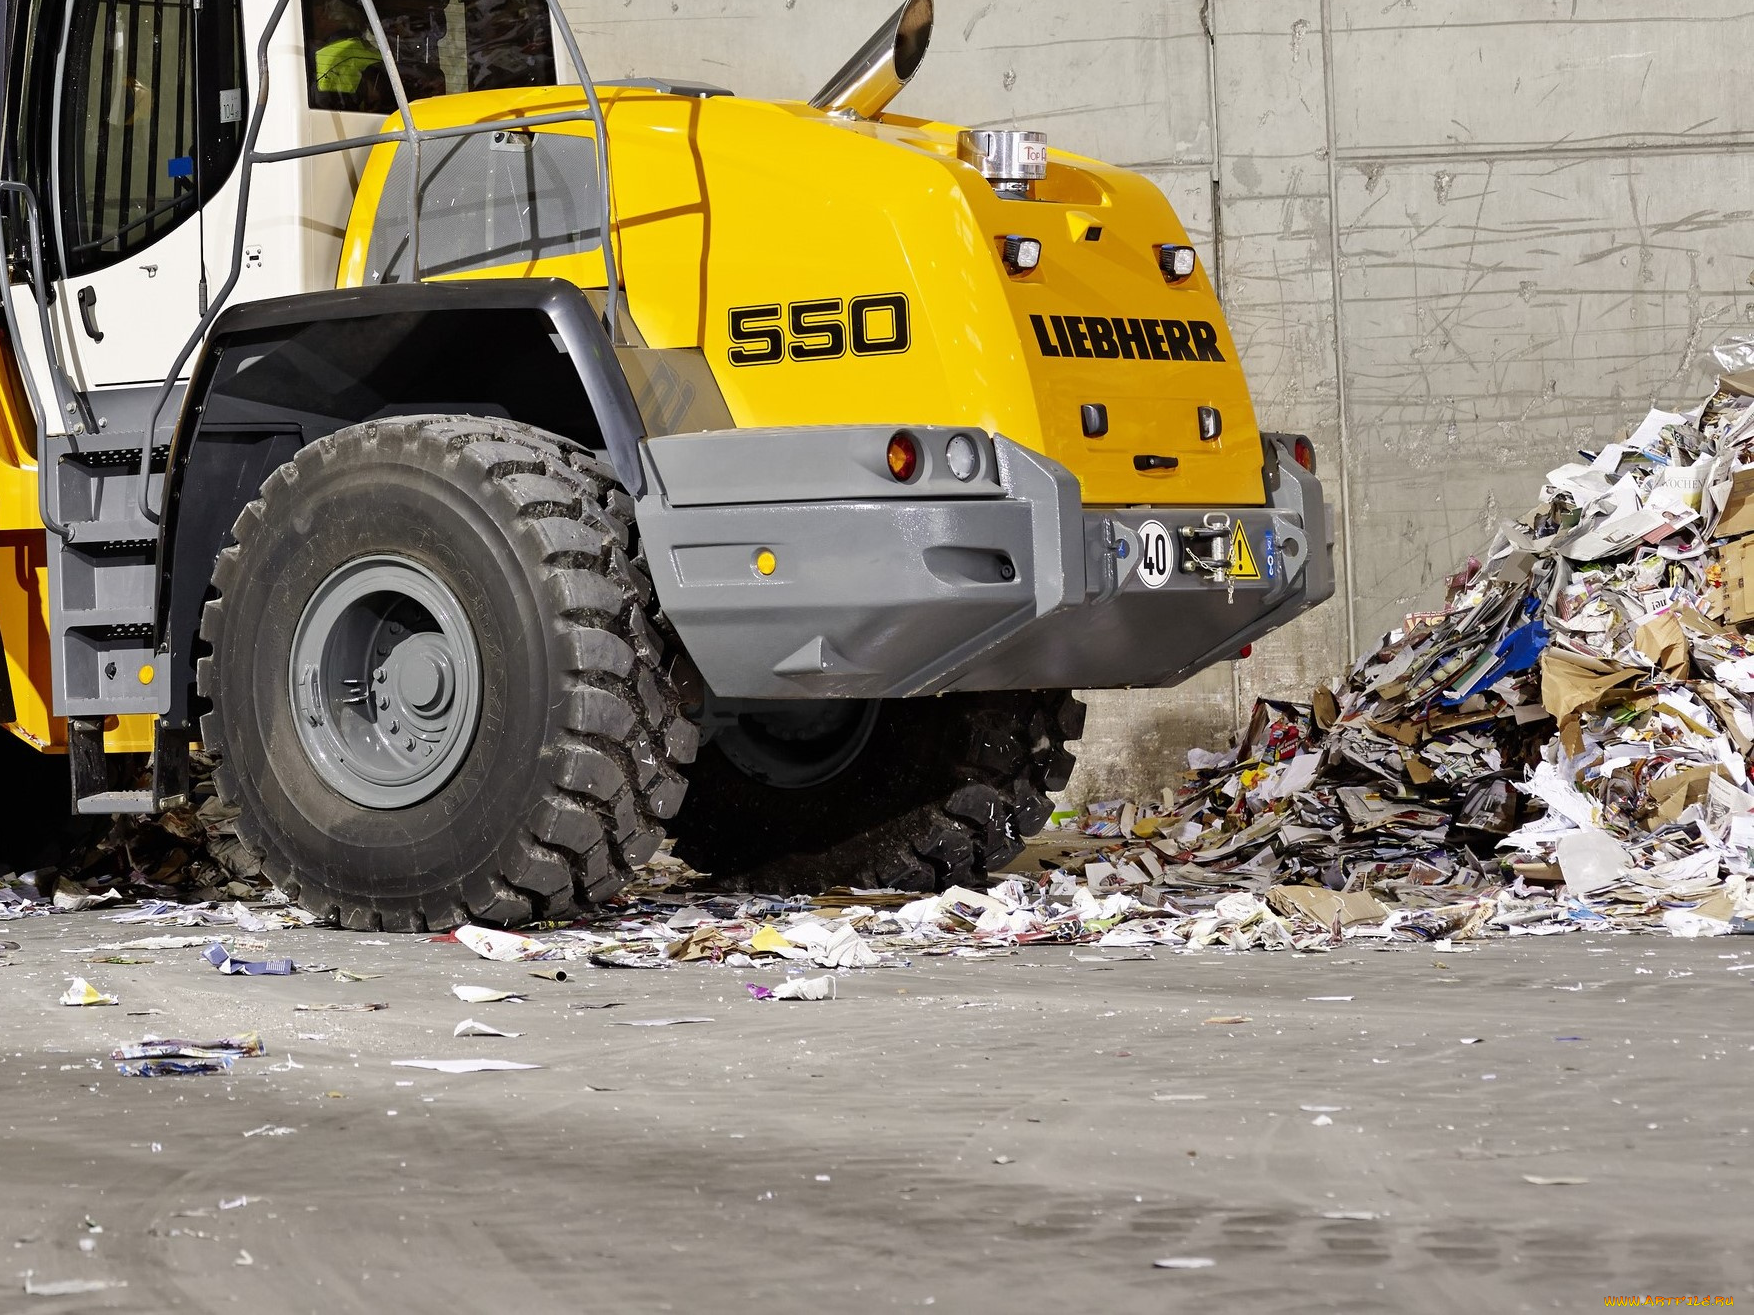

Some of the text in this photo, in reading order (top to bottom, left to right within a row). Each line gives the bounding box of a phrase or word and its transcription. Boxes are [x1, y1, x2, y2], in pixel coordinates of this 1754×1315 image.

[728, 292, 911, 367] 550
[1029, 314, 1226, 362] LIEBHERR
[1144, 533, 1167, 576] 40
